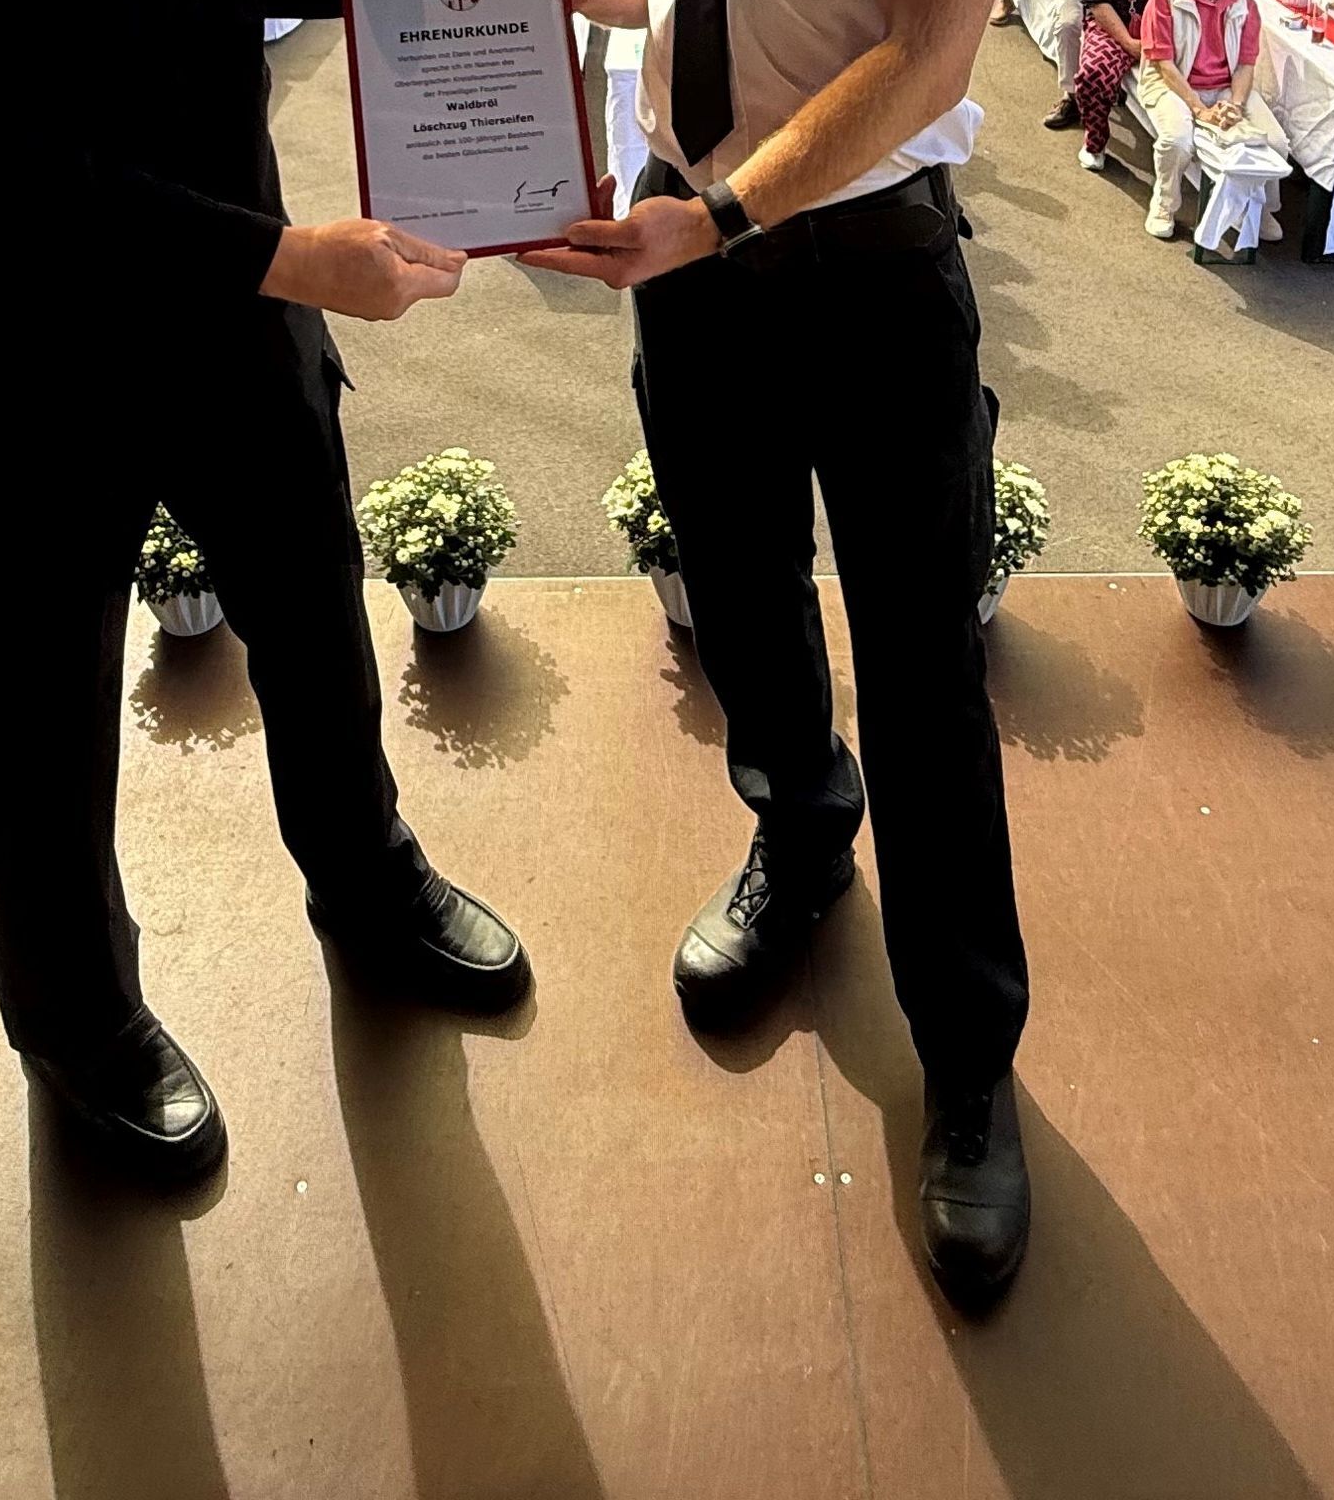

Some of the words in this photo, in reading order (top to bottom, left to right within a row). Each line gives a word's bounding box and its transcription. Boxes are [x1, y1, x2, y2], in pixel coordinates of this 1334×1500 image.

[399, 21, 530, 44] EHRENURKUNDE
[446, 98, 498, 111] Waldbröl
[413, 120, 467, 133] Löschzug
[470, 114, 535, 128] Thierseifen
